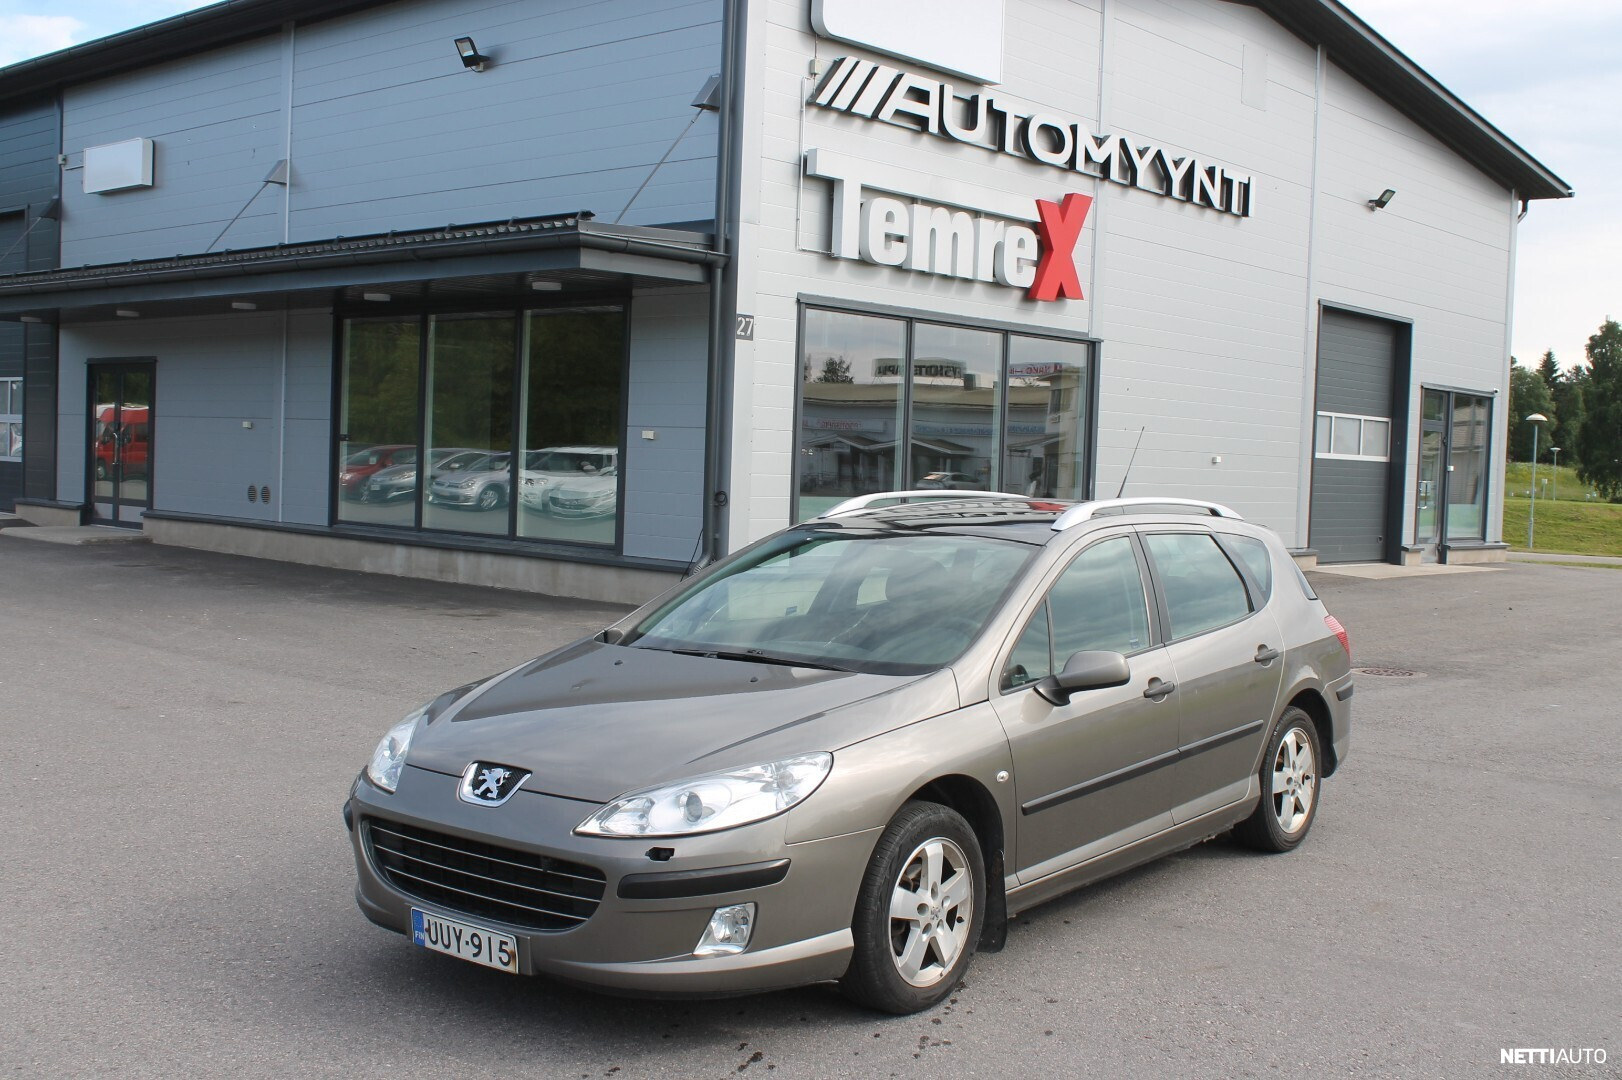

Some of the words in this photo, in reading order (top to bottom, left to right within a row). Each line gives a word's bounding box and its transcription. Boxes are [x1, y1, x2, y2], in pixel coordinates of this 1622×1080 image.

[877, 72, 1256, 217] AUTOMYYNTI
[736, 316, 754, 337] 27
[427, 919, 512, 967] UUY-915
